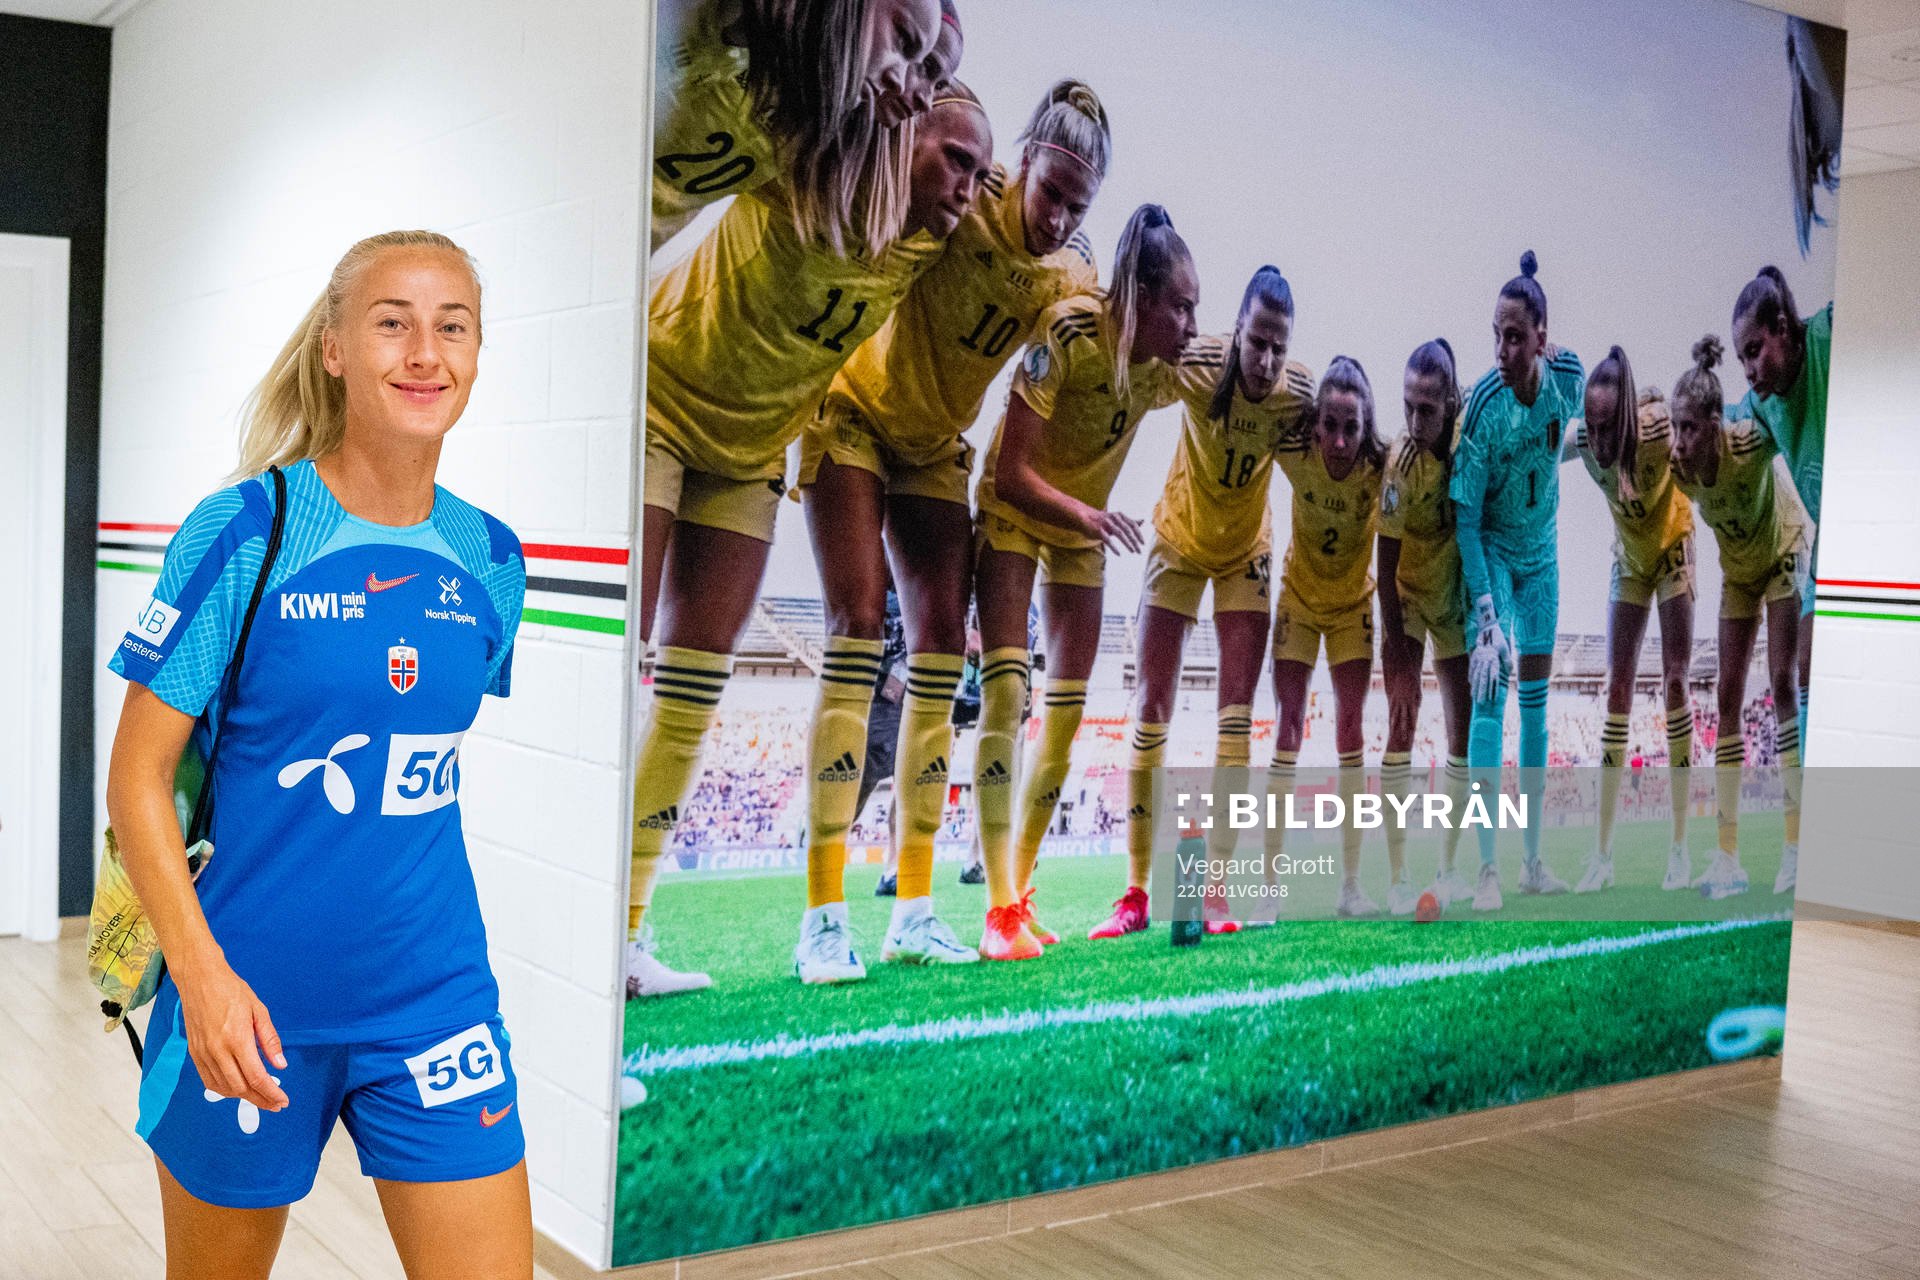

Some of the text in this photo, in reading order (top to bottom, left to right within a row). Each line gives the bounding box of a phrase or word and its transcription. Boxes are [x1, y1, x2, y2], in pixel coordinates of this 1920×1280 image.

[656, 131, 756, 194] 20
[796, 288, 867, 352] 11
[958, 303, 1020, 357] 10
[1104, 410, 1127, 449] 9
[1218, 448, 1256, 489] 18
[1526, 470, 1537, 508] 1
[1321, 528, 1339, 555] 2
[280, 592, 339, 620] KIWI
[341, 592, 367, 605] mini
[342, 605, 365, 621] pris
[425, 608, 477, 626] Norsk Tipping
[428, 1041, 493, 1091] 5G
